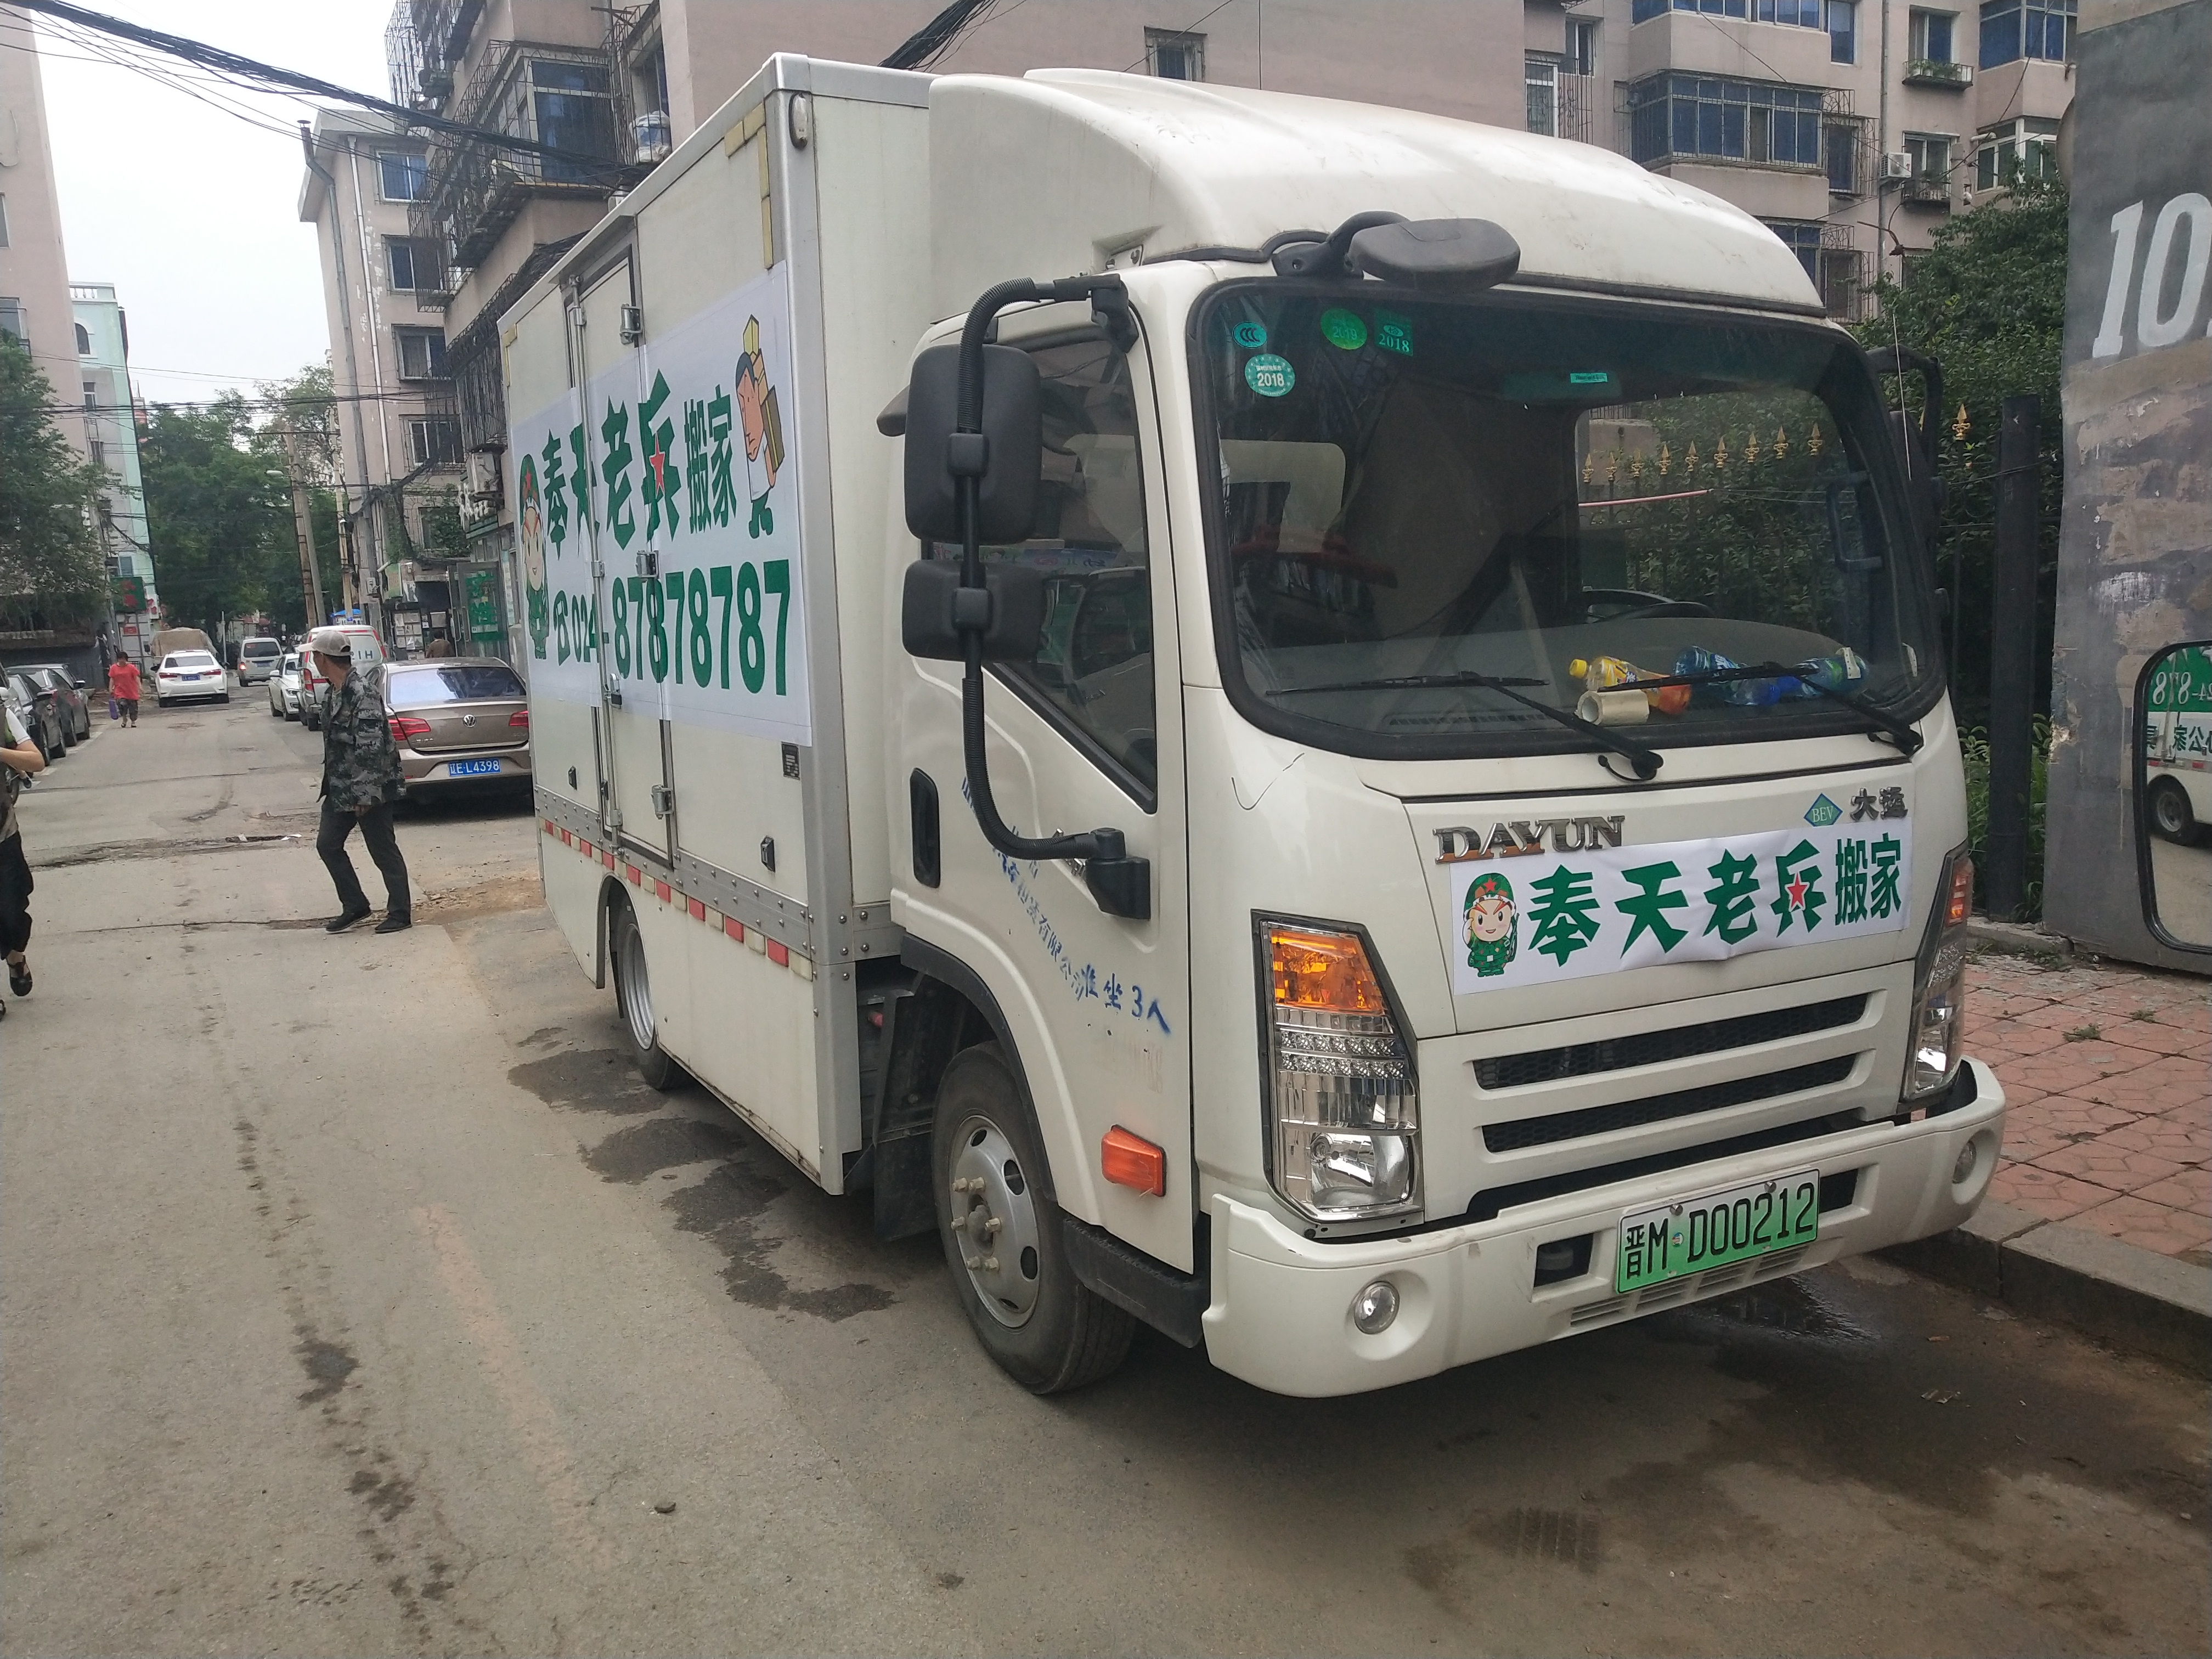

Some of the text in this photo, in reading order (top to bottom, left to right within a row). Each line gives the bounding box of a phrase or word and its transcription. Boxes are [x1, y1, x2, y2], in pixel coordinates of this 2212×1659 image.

[1333, 326, 1357, 340] 2019
[1378, 333, 1410, 353] 2018
[1257, 373, 1285, 387] 2018
[1812, 806, 1833, 822] BEV
[1432, 815, 1626, 865] DAYUN
[1528, 832, 1902, 967] 奉天老兵搬家
